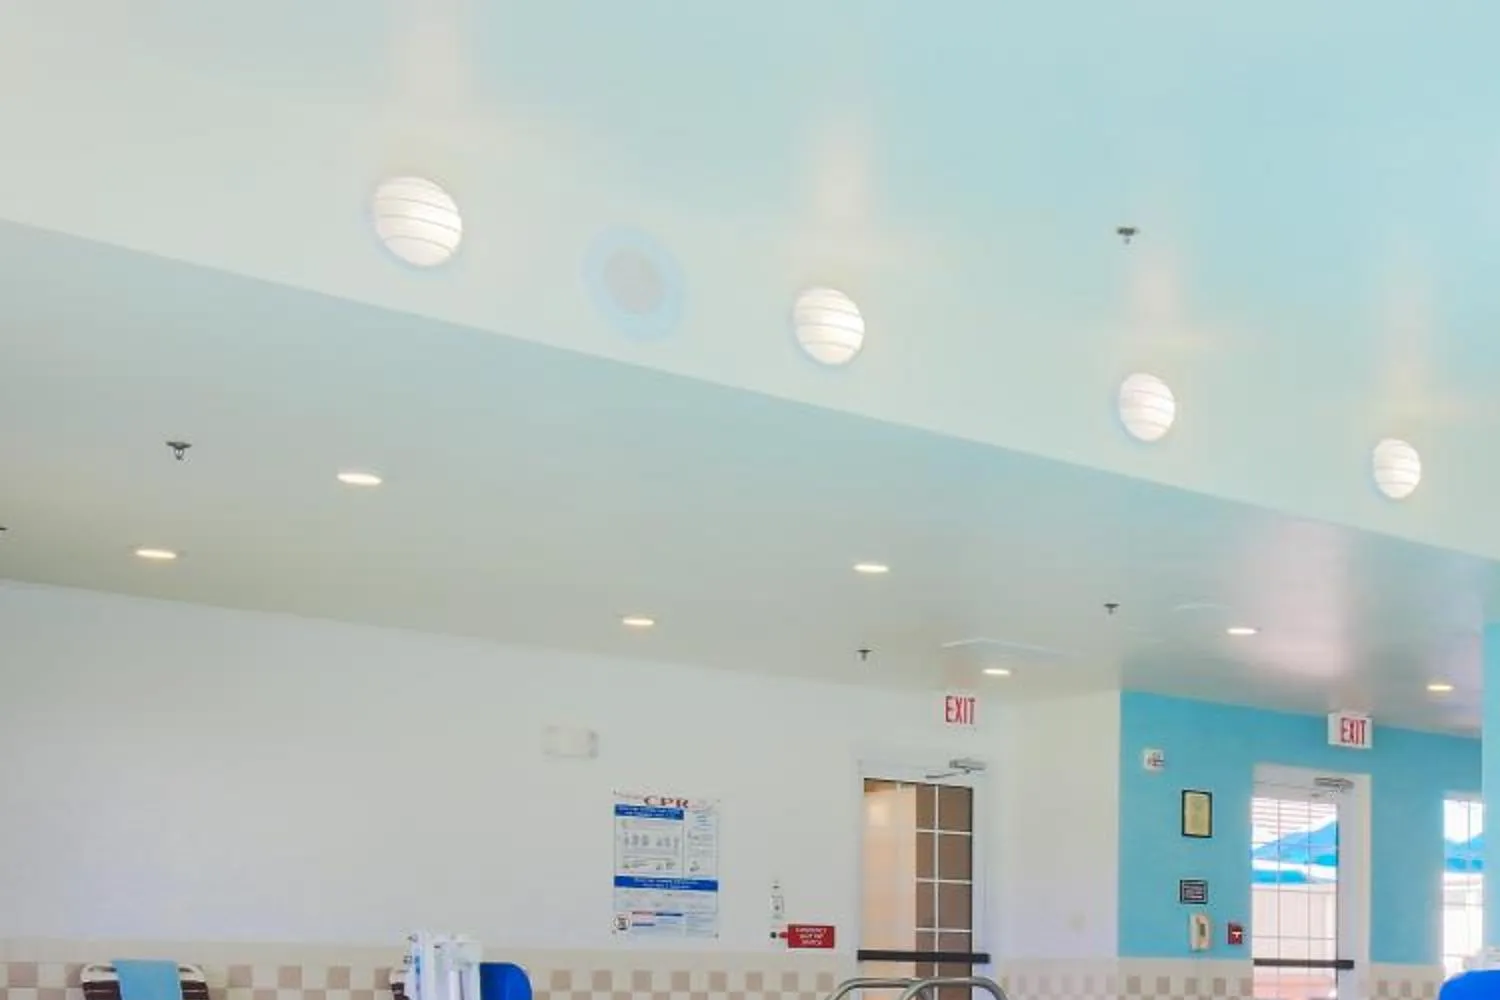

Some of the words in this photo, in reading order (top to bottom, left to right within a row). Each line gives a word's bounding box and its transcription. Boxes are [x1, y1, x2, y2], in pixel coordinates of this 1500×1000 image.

[945, 695, 975, 725] EXIT
[1340, 717, 1366, 745] EXIT
[643, 796, 688, 808] CPR
